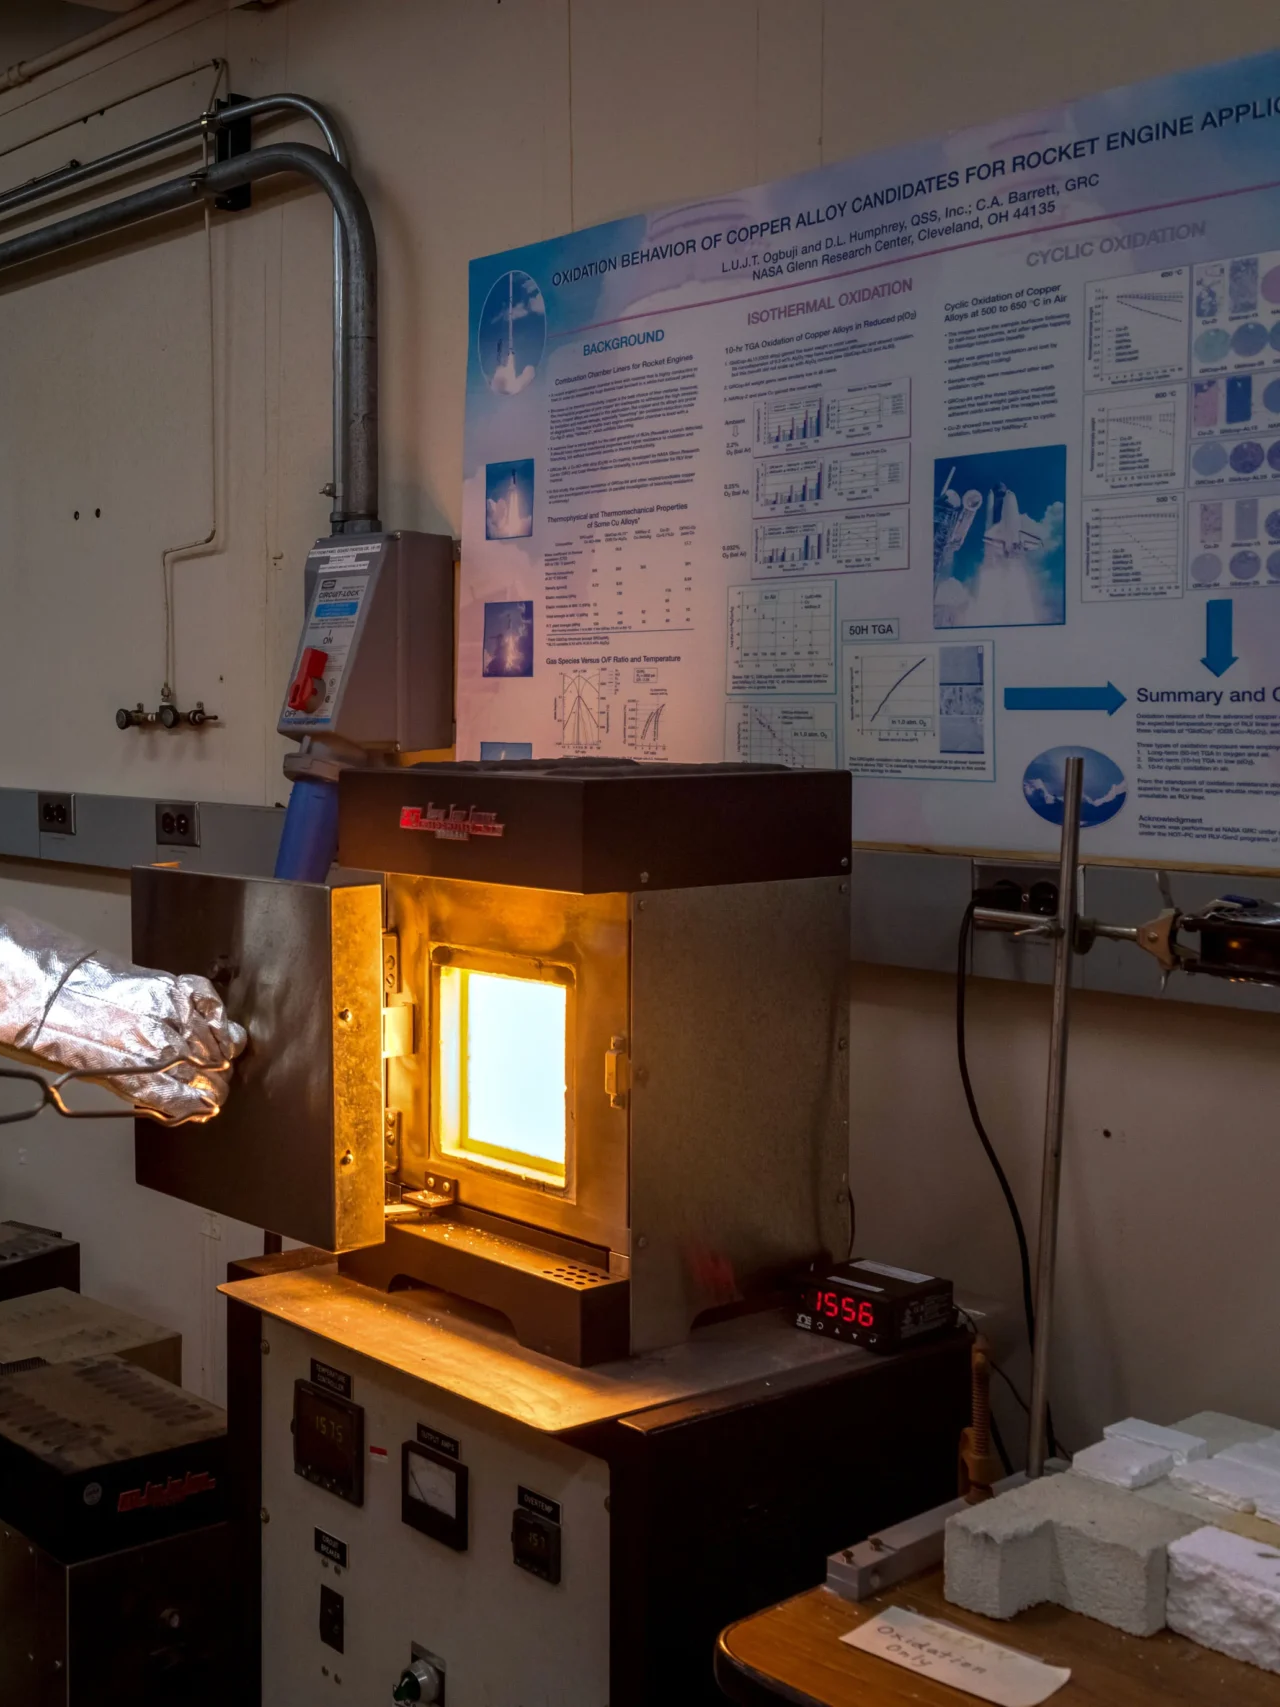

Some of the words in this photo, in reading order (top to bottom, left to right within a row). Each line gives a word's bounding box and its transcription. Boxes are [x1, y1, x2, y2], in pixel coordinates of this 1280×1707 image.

[552, 256, 617, 286] OXIDATION
[621, 239, 696, 268] BEHAVIOR
[701, 233, 722, 251] OF
[727, 216, 791, 246] COPPER
[795, 201, 847, 228] ALLOY
[852, 171, 959, 214] CANDIDATES
[965, 159, 1006, 184] FOR
[1012, 137, 1100, 173] ROCKET
[1106, 115, 1194, 151] ENGINE
[722, 255, 759, 273] L.U.J.T.
[763, 245, 798, 266] Ogbuji
[801, 240, 821, 256] and
[825, 236, 845, 249] D.L.
[850, 221, 907, 244] Humphrey,
[910, 210, 940, 229] QSS,
[976, 195, 1003, 211] C.A.
[1008, 184, 1060, 205] Barrett,
[1065, 173, 1099, 192] GRC
[752, 266, 783, 281] NASA
[786, 258, 818, 274] Glenn
[822, 241, 872, 266] Research
[875, 234, 914, 257] Center,
[918, 217, 983, 242] Cleveland,
[987, 210, 1008, 226] OH
[1013, 201, 1056, 220] 44135
[1026, 242, 1094, 267] CYCLIC
[1099, 220, 1207, 254] OXIDATION
[747, 296, 835, 326] ISOTHERMAL
[838, 278, 913, 307] OXIDATION
[944, 300, 969, 313] Cyclic
[971, 291, 1012, 308] Oxidation
[1014, 289, 1024, 299] of
[1026, 284, 1061, 298] Copper
[944, 312, 969, 323] Alloys
[970, 309, 979, 319] at
[981, 305, 997, 317] 500
[999, 303, 1008, 313] to
[1010, 300, 1027, 311] 650
[1043, 296, 1051, 306] in
[1053, 294, 1067, 304] Air
[583, 329, 665, 356] BACKGROUND
[725, 345, 743, 355] 10-hr
[745, 342, 760, 351] TGA
[761, 335, 794, 348] Oxidation
[795, 333, 803, 343] of
[804, 329, 831, 342] Copper
[832, 323, 854, 335] Alloys
[855, 322, 862, 330] in
[863, 315, 896, 328] Reduced
[555, 374, 587, 386] Combustion
[588, 369, 612, 380] Chamber
[613, 365, 631, 374] Liners
[632, 361, 641, 370] for
[642, 358, 665, 368] Rocket
[666, 354, 693, 365] Engines
[547, 512, 588, 523] Thermophysical
[601, 506, 655, 518] Thermomechanical
[656, 502, 688, 512] Properties
[587, 521, 593, 529] of
[594, 519, 610, 528] Some
[611, 518, 619, 526] Cu
[322, 636, 333, 645] ON
[849, 625, 869, 635] 50H
[871, 624, 894, 635] TGA
[546, 657, 557, 665] Gas
[558, 656, 580, 665] Species
[580, 656, 600, 664] Versus
[601, 655, 613, 664] O/F
[613, 655, 629, 663] Ratio
[630, 655, 641, 663] and
[643, 654, 681, 664] Temperature
[1137, 687, 1224, 706] Summary
[1230, 687, 1265, 702] and
[816, 1290, 874, 1328] 1556
[523, 1494, 554, 1514] OVERTEMP
